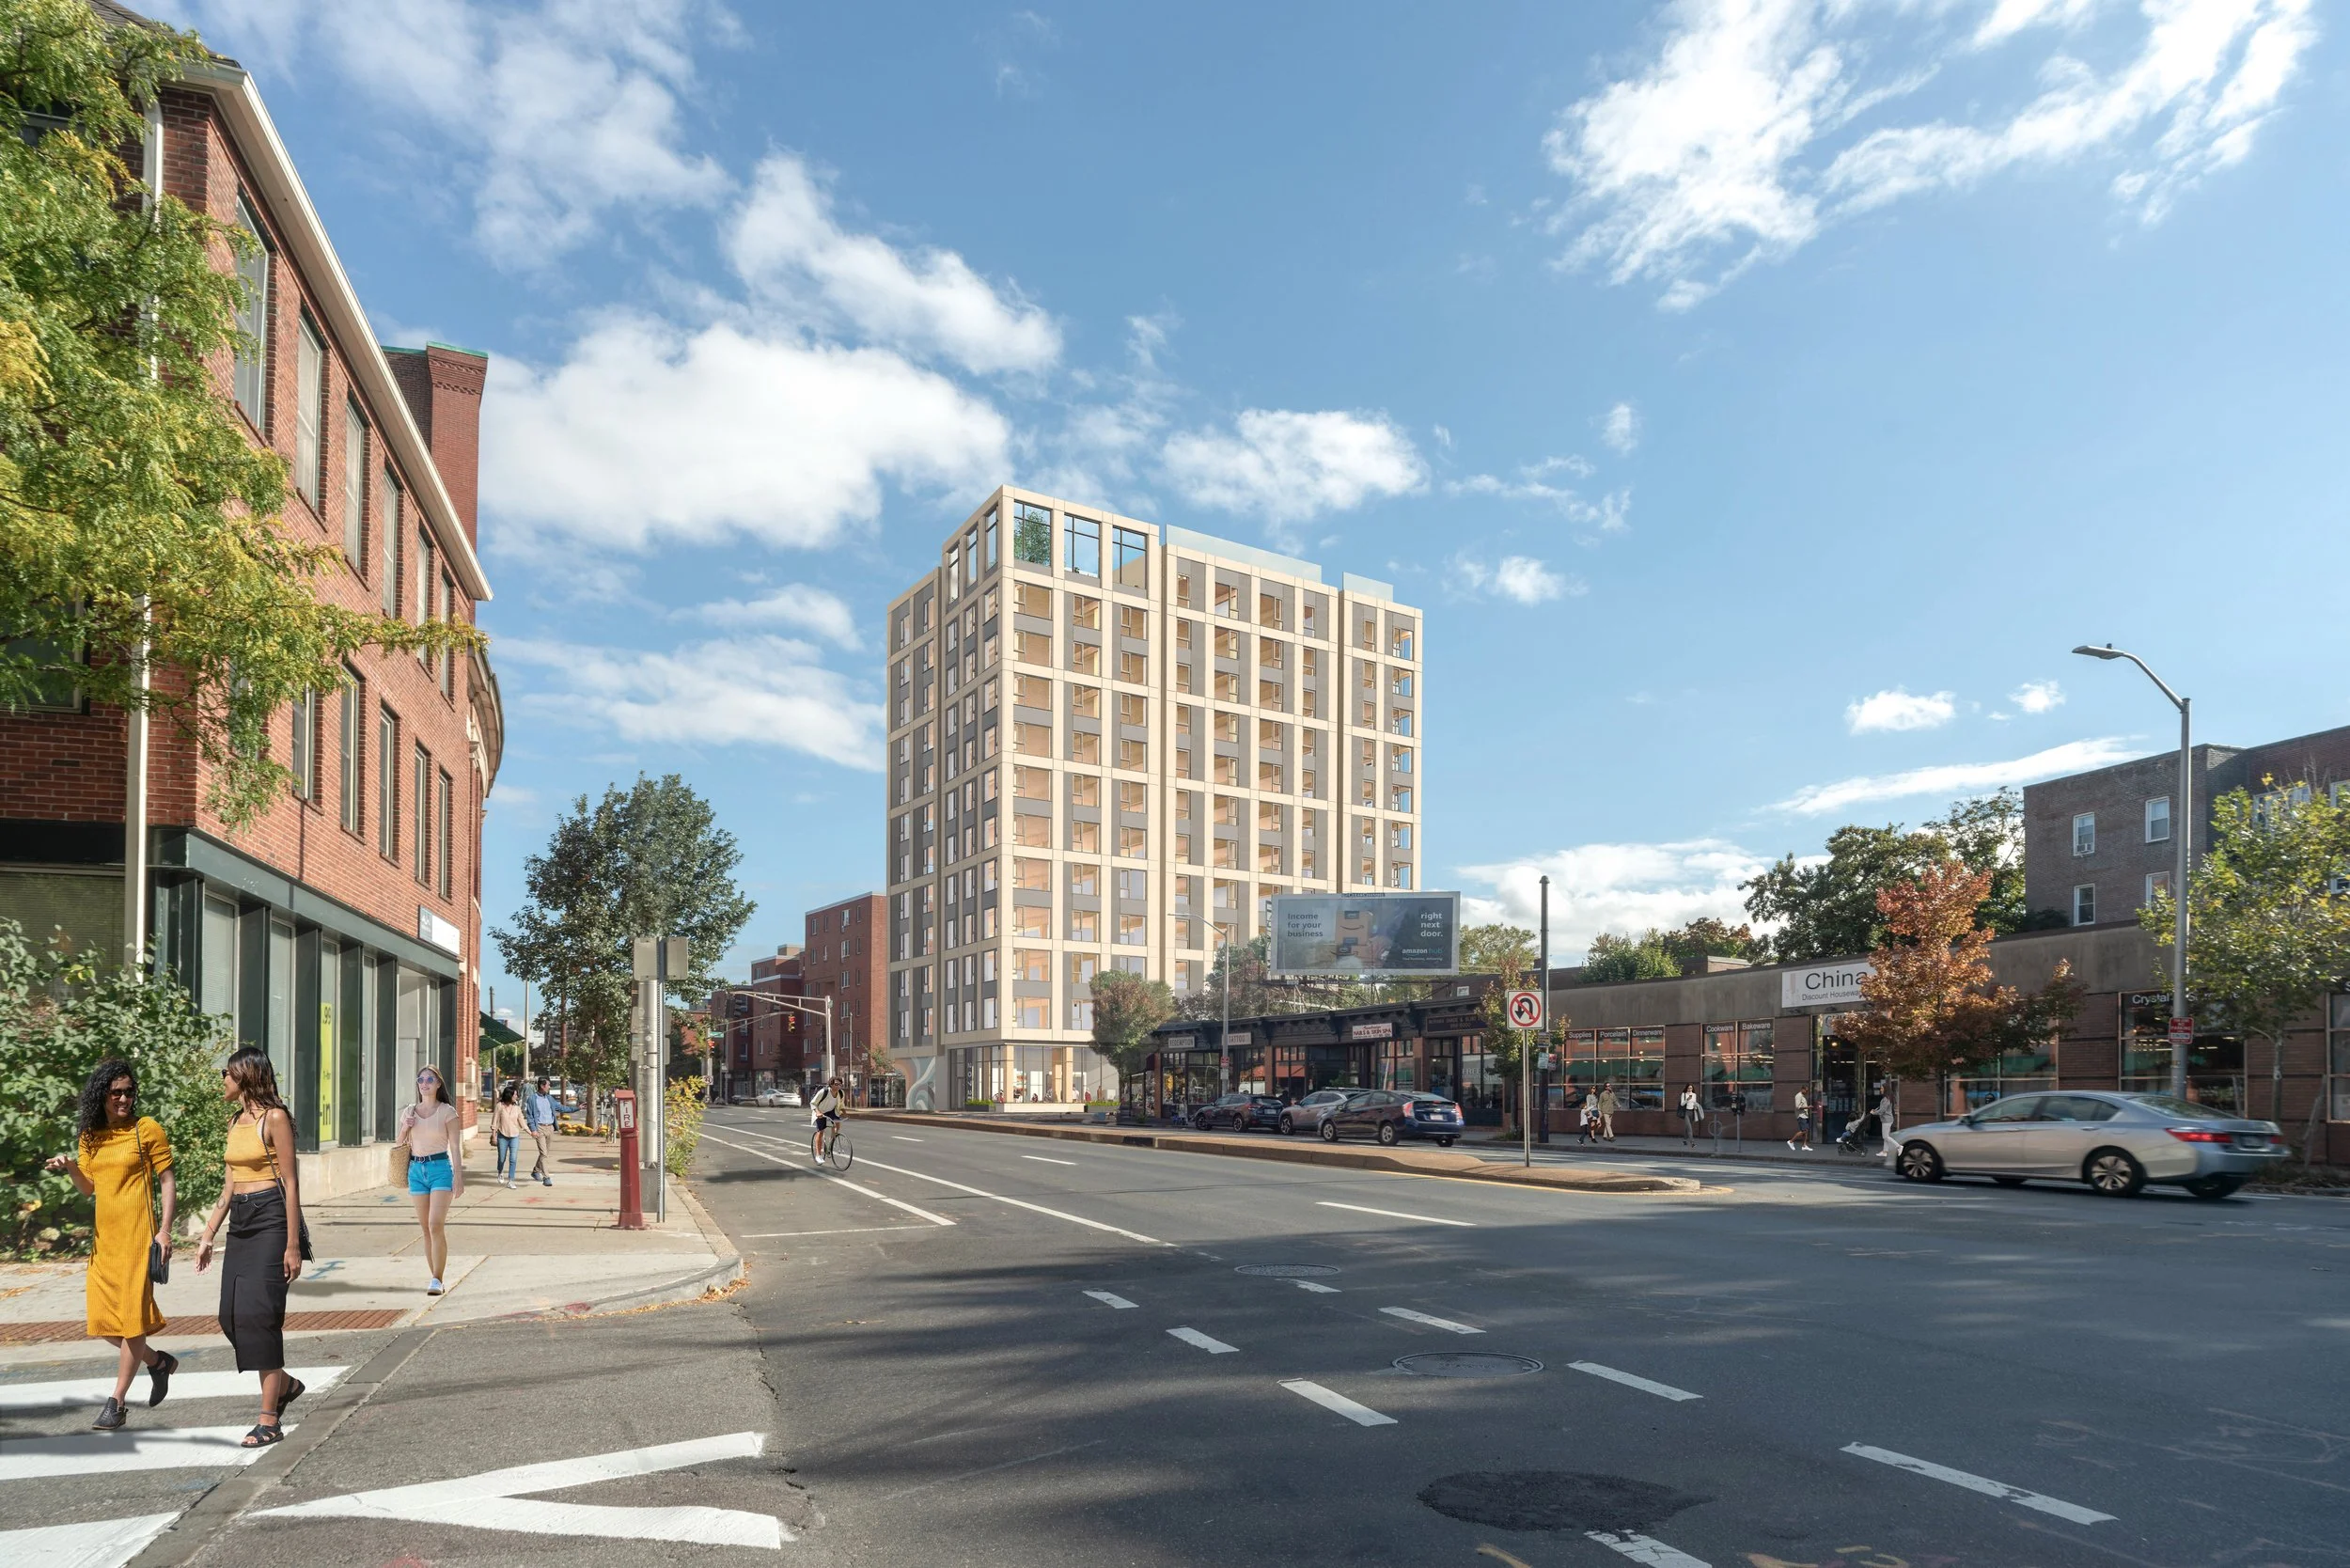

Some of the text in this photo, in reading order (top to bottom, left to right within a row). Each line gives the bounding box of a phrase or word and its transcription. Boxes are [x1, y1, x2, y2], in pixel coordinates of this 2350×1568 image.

[1420, 912, 1442, 920] right
[1802, 992, 1828, 1001] Discount
[2132, 993, 2170, 1005] Crystal
[1742, 1022, 1771, 1030] Bakeware
[1169, 1038, 1194, 1046] REDEMPTION
